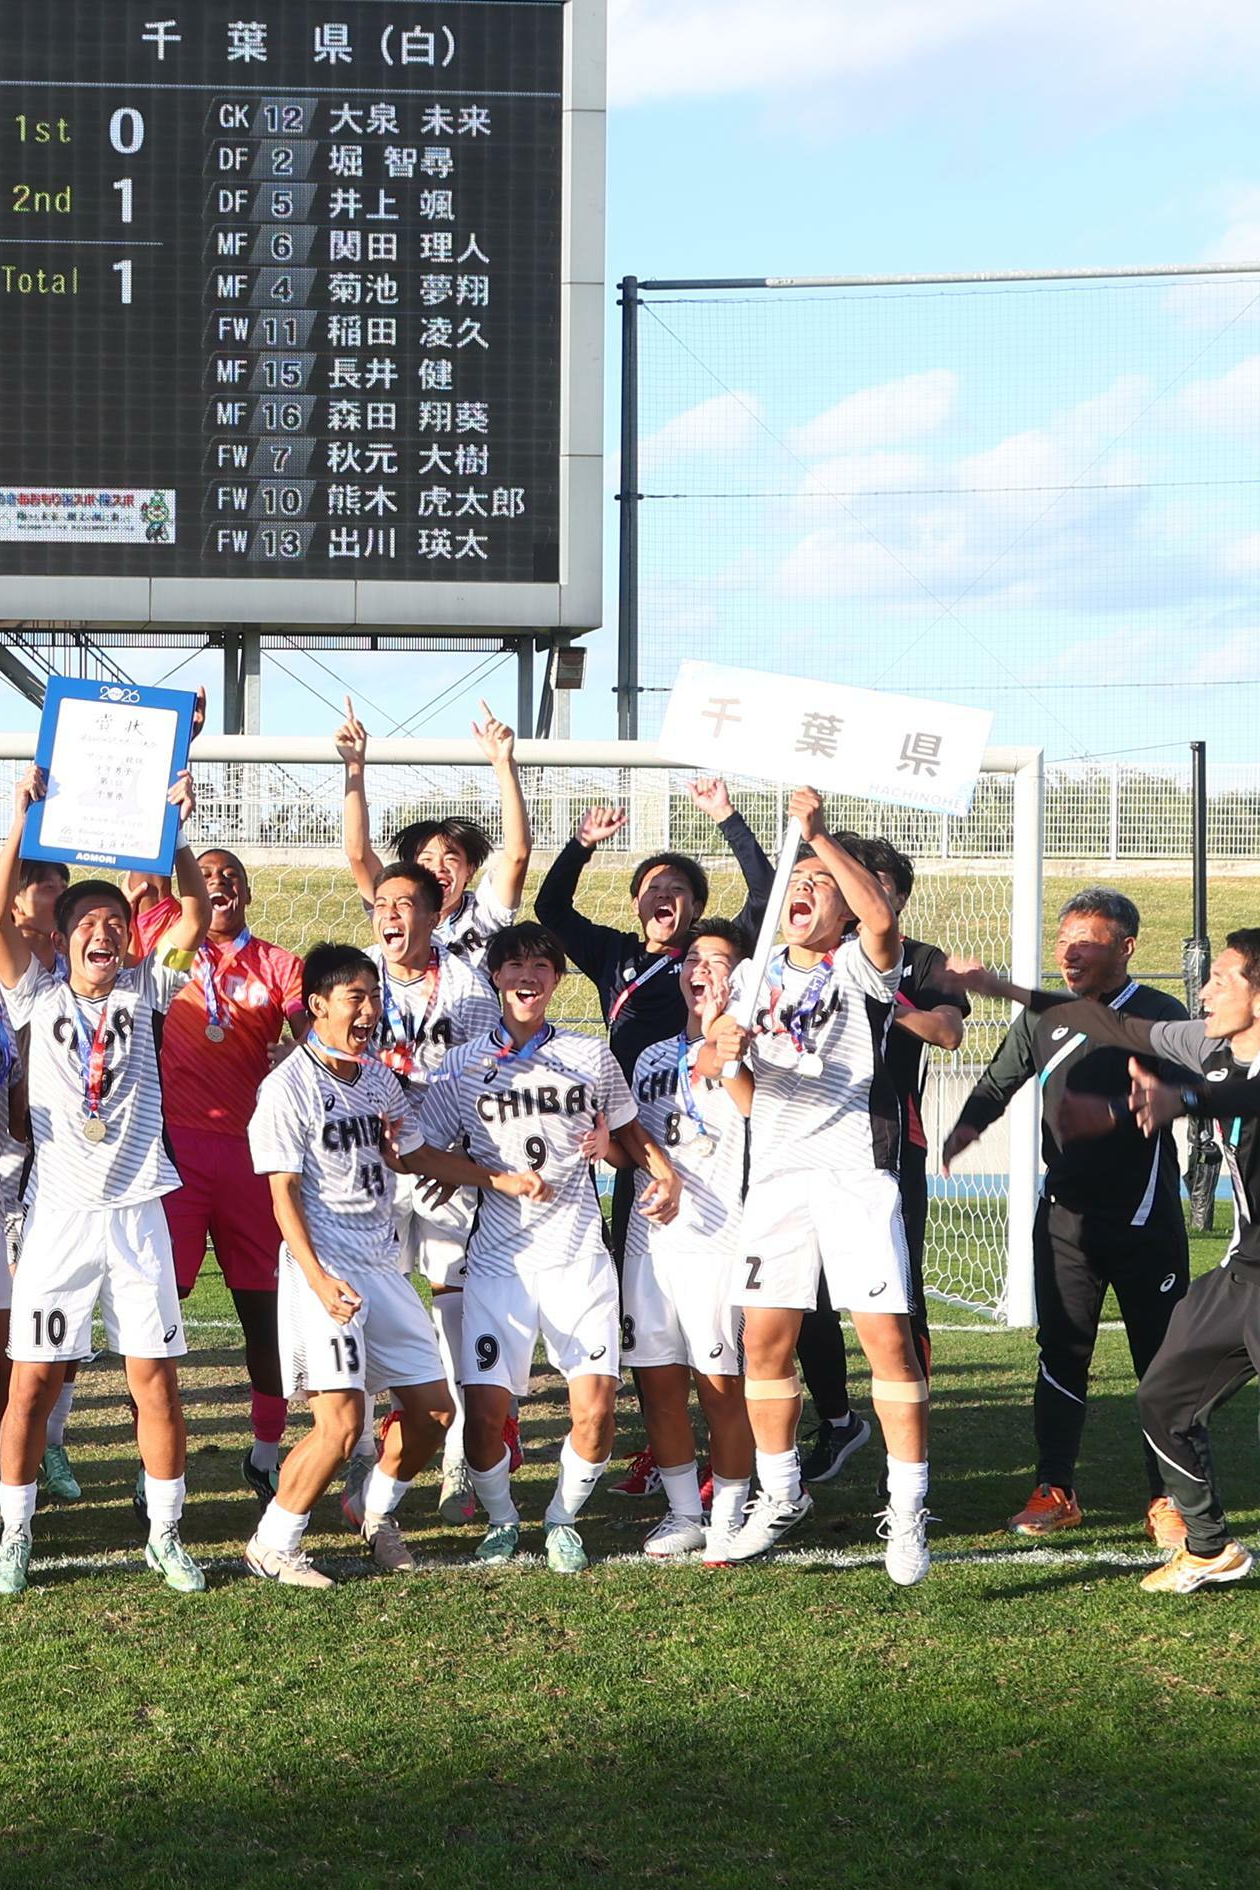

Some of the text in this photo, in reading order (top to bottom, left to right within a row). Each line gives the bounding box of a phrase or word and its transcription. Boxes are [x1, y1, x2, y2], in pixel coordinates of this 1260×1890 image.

[220, 104, 248, 127] GK
[264, 106, 303, 133] 12
[330, 103, 490, 136] 大泉 未来
[16, 115, 72, 143] 1st
[109, 107, 144, 154] 0
[220, 148, 247, 170] DF
[272, 149, 294, 176] 2
[329, 145, 453, 178] 堀 智尋
[12, 185, 71, 212] 2nd
[113, 178, 132, 222] 1
[220, 190, 247, 212] DF
[271, 192, 294, 218] 5
[330, 189, 454, 220] 井上 颯
[218, 233, 247, 255] MF
[270, 234, 293, 261] 6
[330, 231, 489, 263] 関田 理人
[1, 265, 78, 294] Total
[112, 260, 132, 304] 1
[218, 275, 247, 297] MF
[270, 276, 294, 304] 4
[329, 272, 488, 305] 菊池 夢翔
[219, 317, 248, 339] FW
[263, 318, 298, 345] 11
[328, 315, 488, 348] 稲田 凌久
[217, 360, 247, 382] MF
[263, 361, 301, 388] 15
[329, 358, 452, 389] 長井 健
[217, 403, 246, 424] MF
[262, 403, 301, 430] 16
[328, 400, 488, 433] 森田 翔葵
[219, 445, 247, 467] FW
[270, 446, 292, 473] 7
[328, 442, 488, 475] 秋元 大樹
[218, 487, 247, 509] FW
[262, 488, 301, 515] 10
[328, 484, 524, 517] 熊木 虎太郎
[218, 530, 247, 552] FW
[262, 530, 301, 557] 13
[329, 527, 488, 559] 出川 瑛太
[76, 853, 116, 864] AOMORI
[476, 1083, 587, 1126] CHIBA
[663, 1110, 682, 1147] 8
[523, 1135, 548, 1173] 9
[744, 1255, 765, 1290] 2
[31, 1308, 68, 1347] 10
[329, 1334, 361, 1374] 13
[475, 1334, 500, 1373] 9
